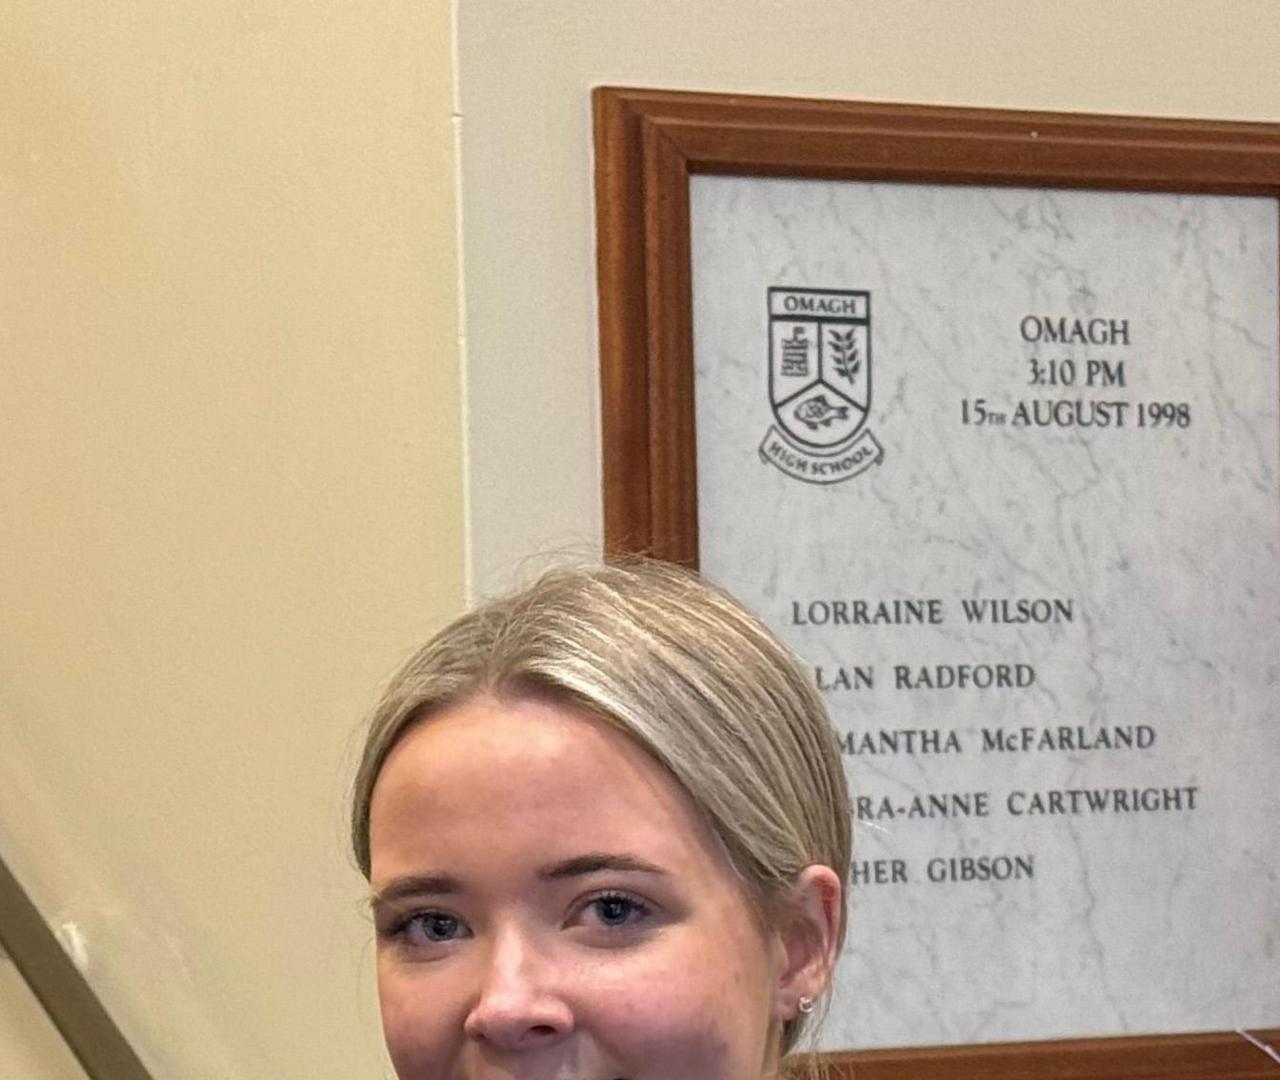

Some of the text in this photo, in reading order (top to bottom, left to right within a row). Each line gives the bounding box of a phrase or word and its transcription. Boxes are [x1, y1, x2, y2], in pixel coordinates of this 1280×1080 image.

[783, 295, 857, 314] OMAGH
[1019, 315, 1131, 345] OMAGH
[1027, 358, 1126, 387] 3:10 PM
[1011, 399, 1130, 428] AUGUST
[1136, 401, 1191, 429] 1998
[769, 441, 874, 475] HIGH SCHOOL
[791, 598, 1073, 626] LORRAINE WILSON
[814, 664, 1037, 691] LAN RADFORD
[838, 724, 1157, 755] MANTHA McFARLAND
[849, 785, 1198, 820] RA-ANNE CARTWRIGHT
[851, 854, 1035, 885] HER GIBSON
